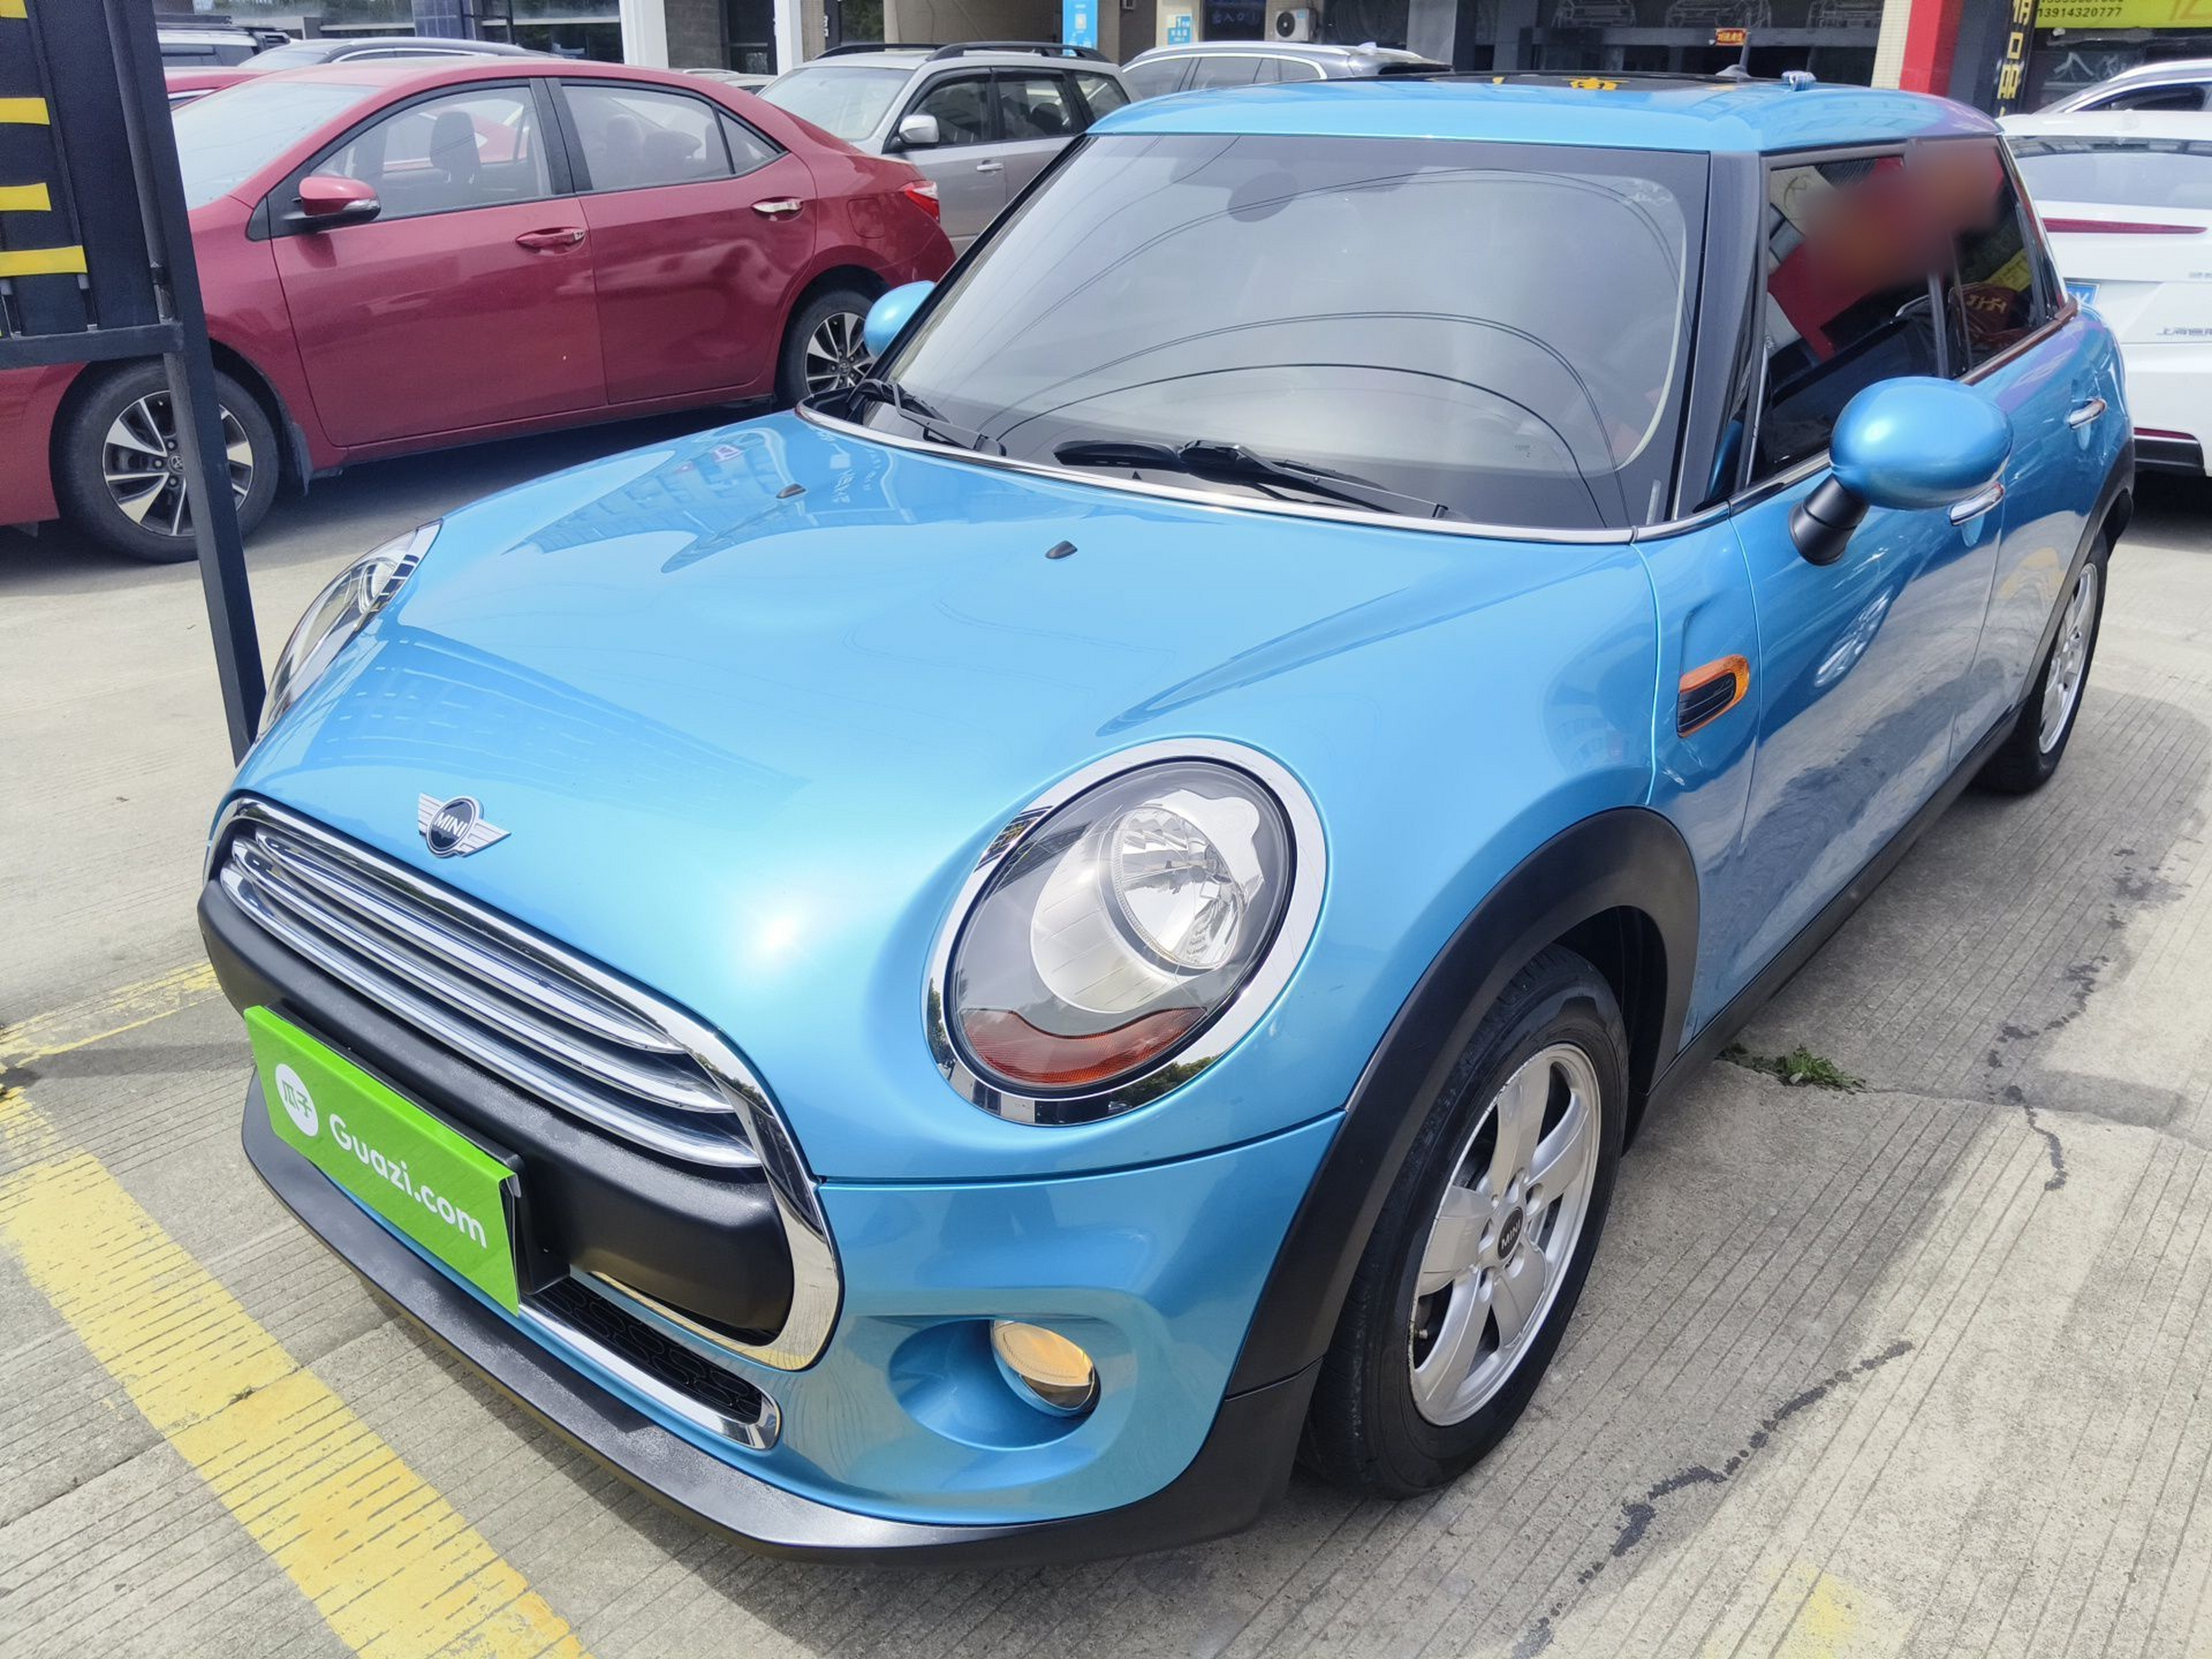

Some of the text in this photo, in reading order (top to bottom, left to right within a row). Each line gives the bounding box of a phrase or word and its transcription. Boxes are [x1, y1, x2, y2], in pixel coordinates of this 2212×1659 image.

[2037, 7, 2122, 18] 13914320777
[434, 812, 468, 838] MINI
[282, 1080, 313, 1118] 瓜子
[329, 1113, 487, 1249] Guazi.com
[1501, 1218, 1520, 1250] MINI
